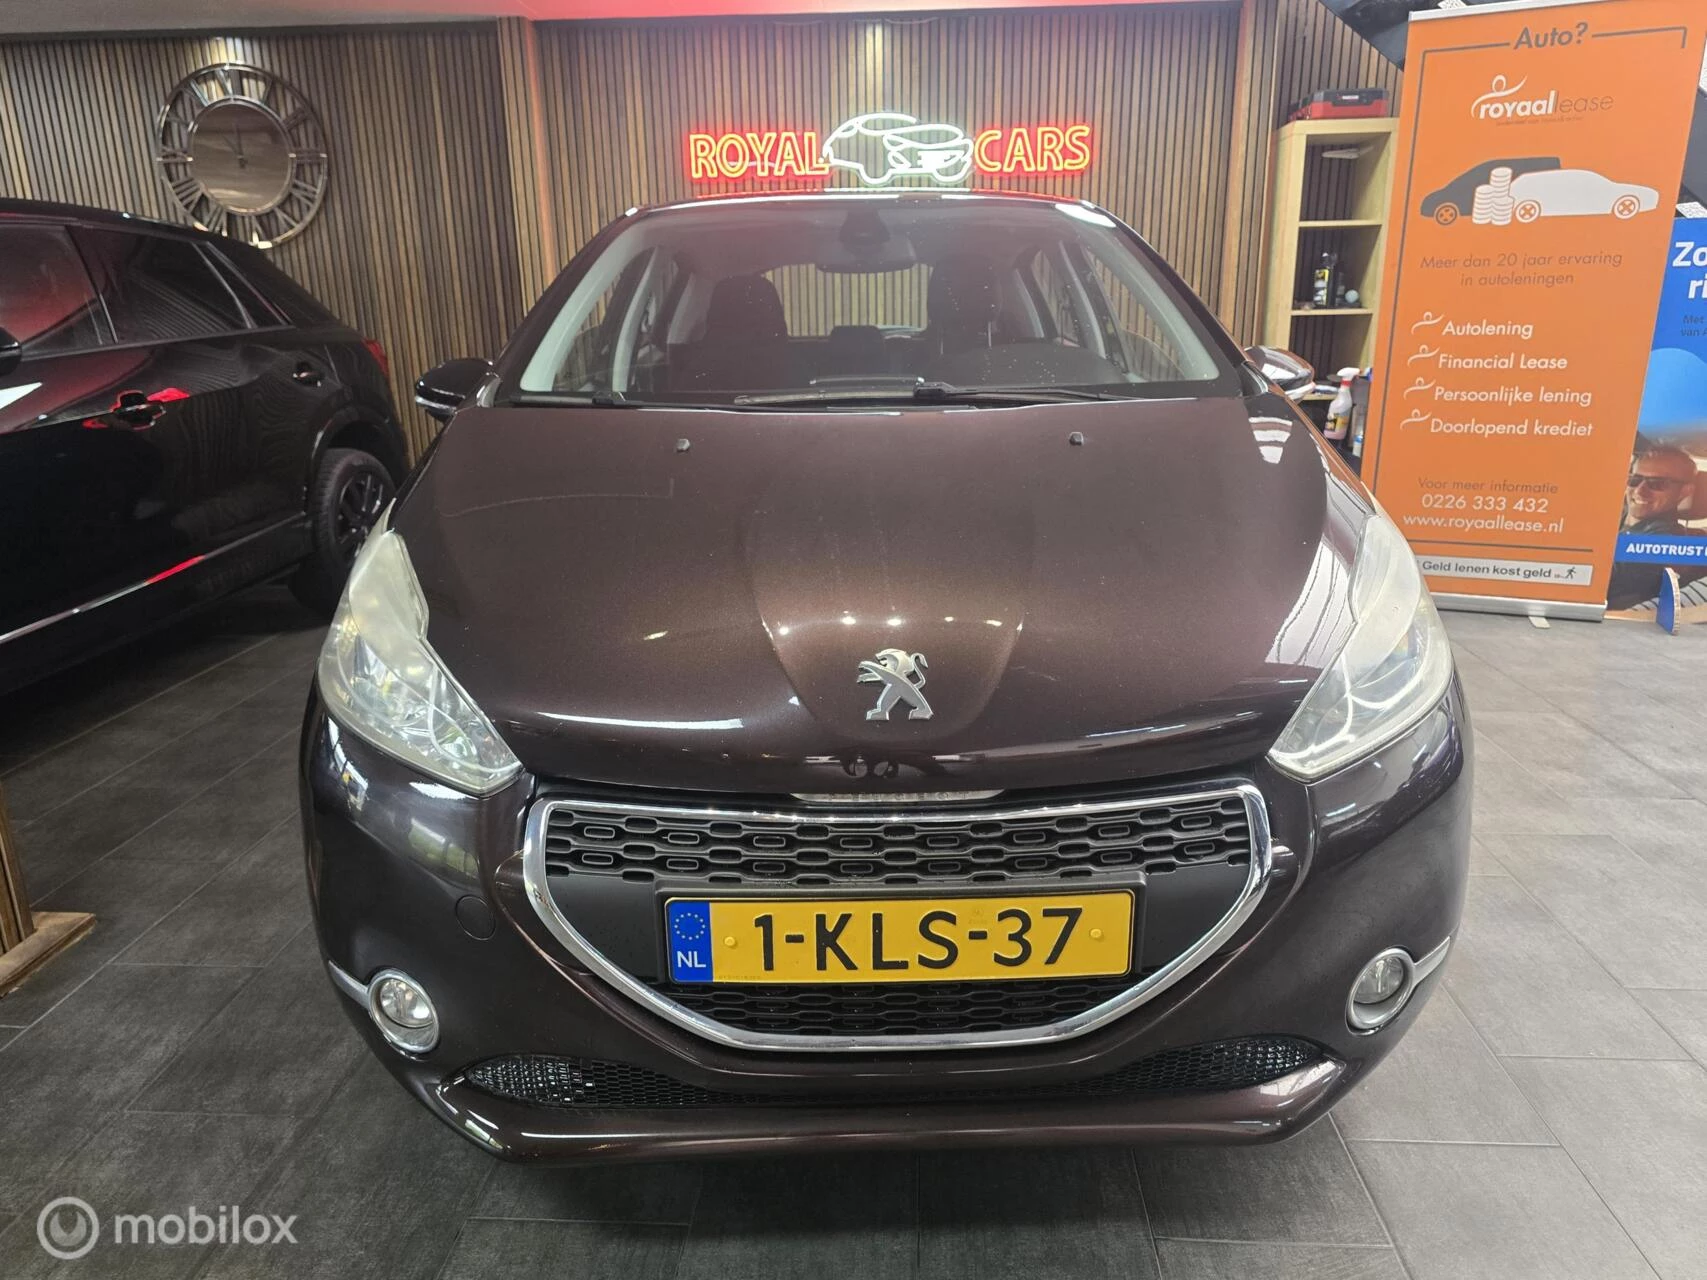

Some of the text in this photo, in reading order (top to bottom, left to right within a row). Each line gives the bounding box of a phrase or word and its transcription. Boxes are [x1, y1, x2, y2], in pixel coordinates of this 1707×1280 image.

[1513, 22, 1588, 50] Auto?
[688, 125, 1091, 179] ROYAL CARS
[1419, 251, 1623, 270] Meer dan 20 jaar ervaring
[1460, 272, 1574, 288] in autoleningen
[1442, 319, 1533, 339] Autolening
[1438, 351, 1568, 369] Financial Lease
[1434, 386, 1592, 407] Persoonlijke lening
[1430, 418, 1594, 438] Doorlopend krediet
[1418, 478, 1559, 494] Voor meer informatie
[1421, 494, 1549, 513] 0226 333 432
[1403, 514, 1564, 535] www.royaallease.nl
[1626, 543, 1704, 557] AUTOTRUST
[1422, 560, 1451, 572] Geld
[1455, 562, 1490, 574] lenen
[1493, 565, 1521, 577] kost
[1523, 567, 1552, 580] geld
[754, 908, 1083, 972] 1-KLS-37
[677, 950, 706, 968] NL
